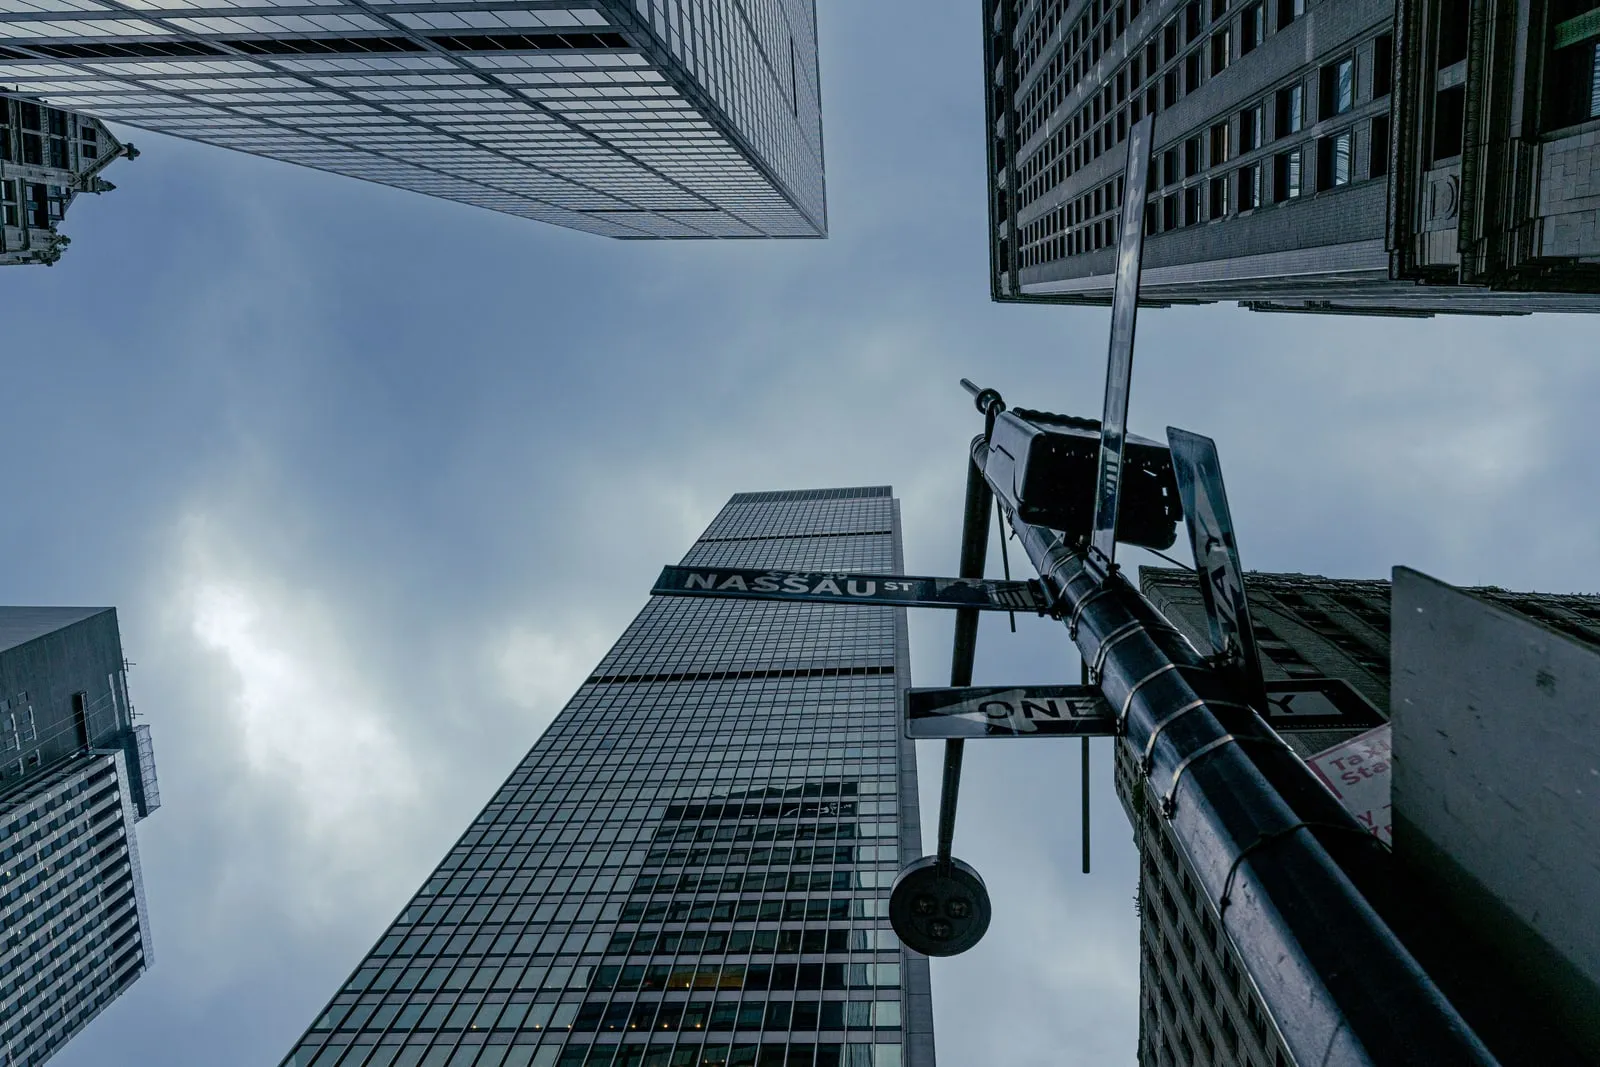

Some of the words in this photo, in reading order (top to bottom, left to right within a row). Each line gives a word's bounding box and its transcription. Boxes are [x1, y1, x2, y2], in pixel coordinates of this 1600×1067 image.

[684, 573, 877, 597] NASSAU
[884, 581, 913, 592] ST
[978, 699, 1100, 719] ONE
